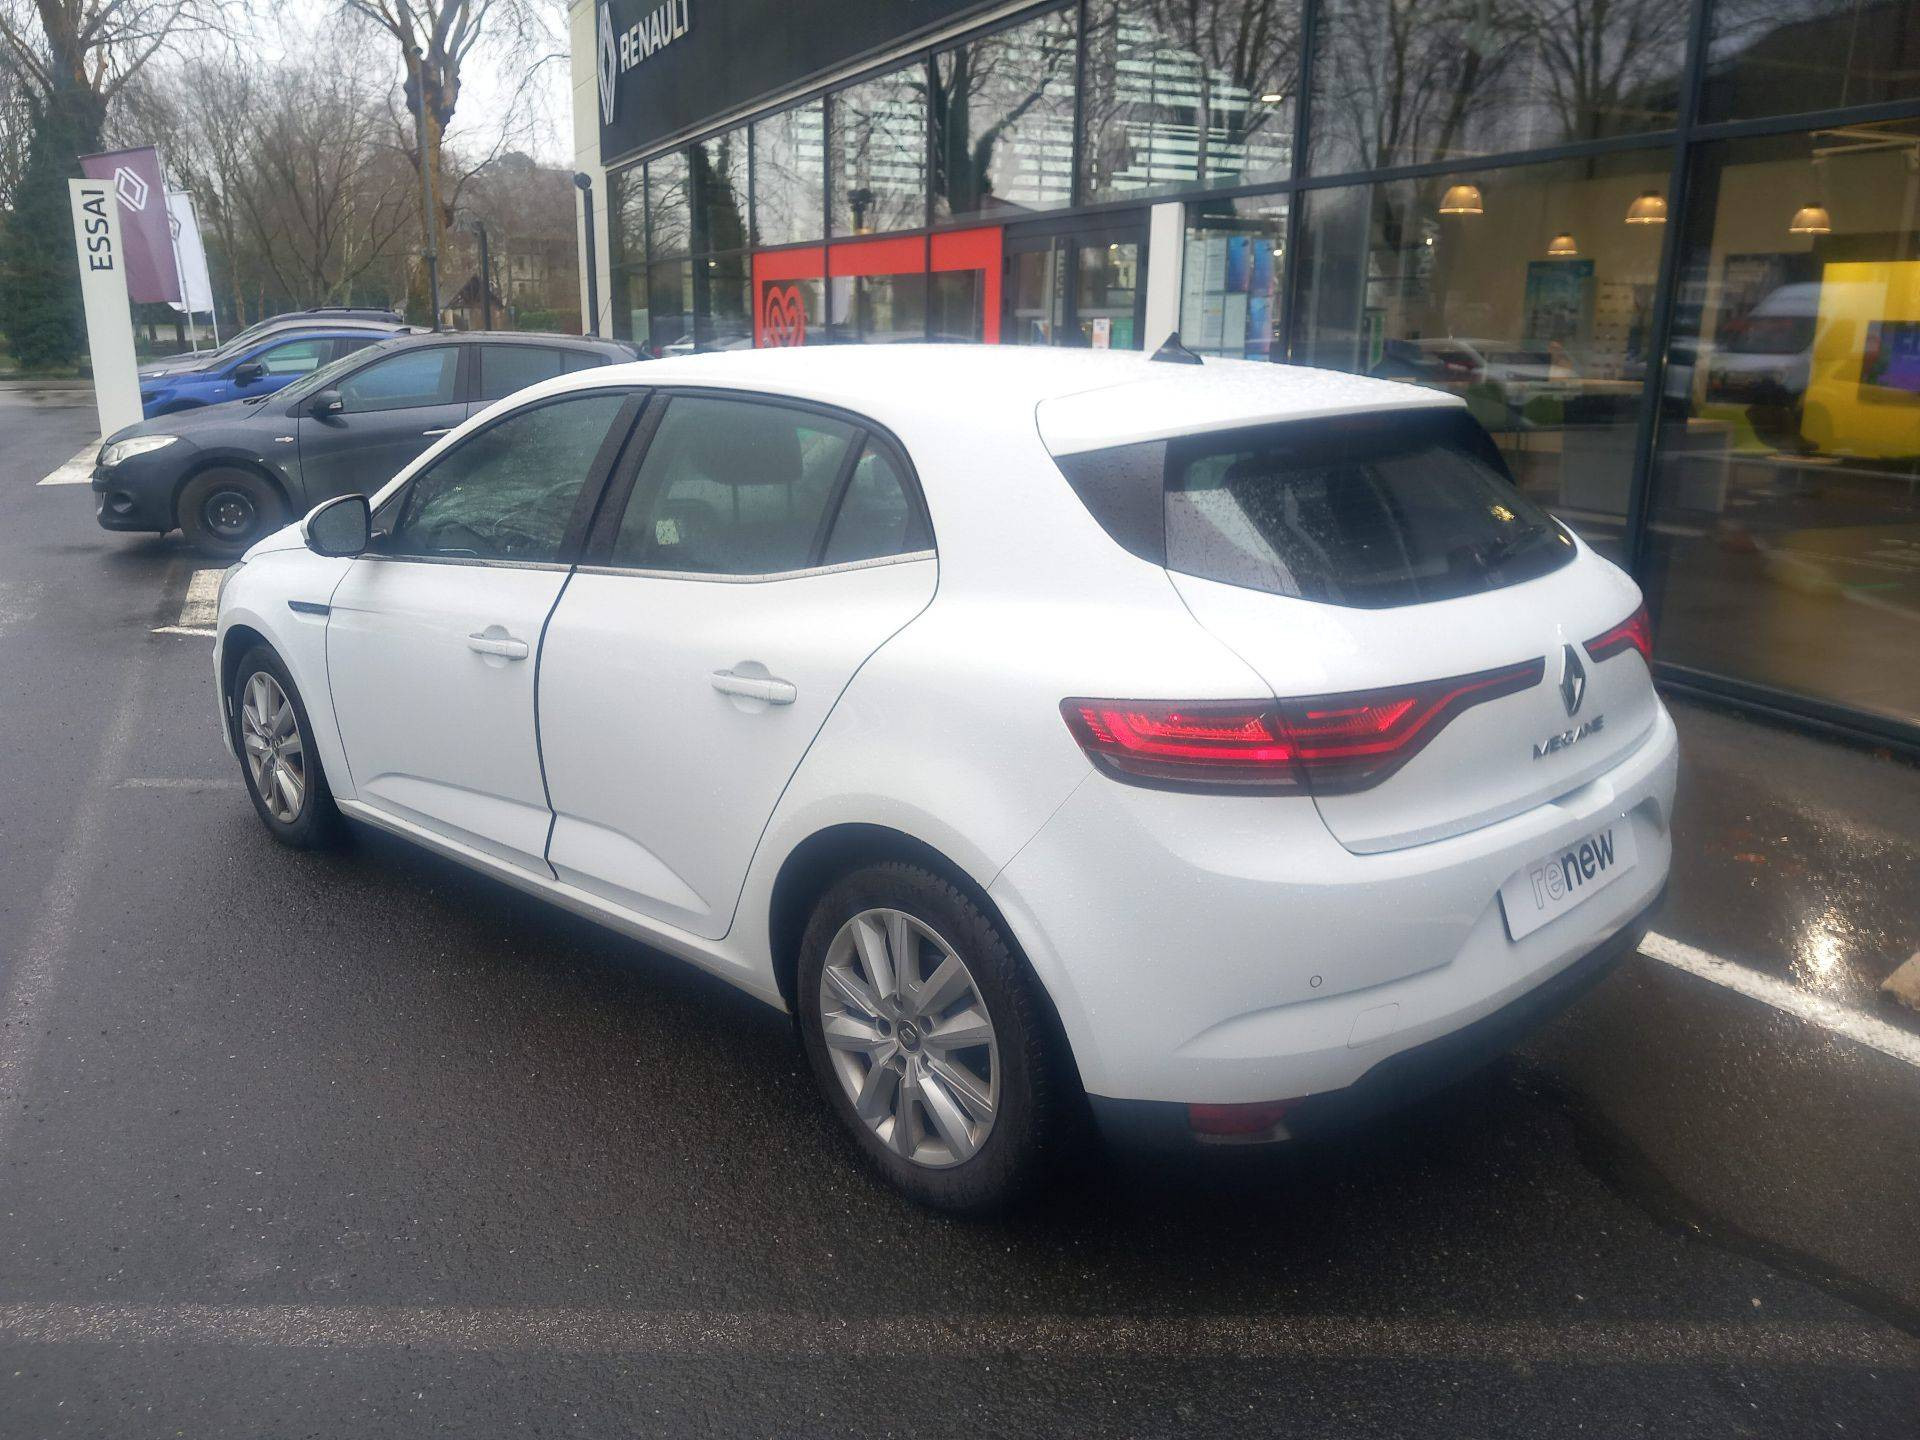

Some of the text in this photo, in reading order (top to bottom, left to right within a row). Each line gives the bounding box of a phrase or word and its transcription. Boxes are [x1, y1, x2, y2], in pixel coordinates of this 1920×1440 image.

[620, 0, 688, 73] RENAULT
[81, 190, 113, 271] ESSAI
[1530, 829, 1615, 910] renew
